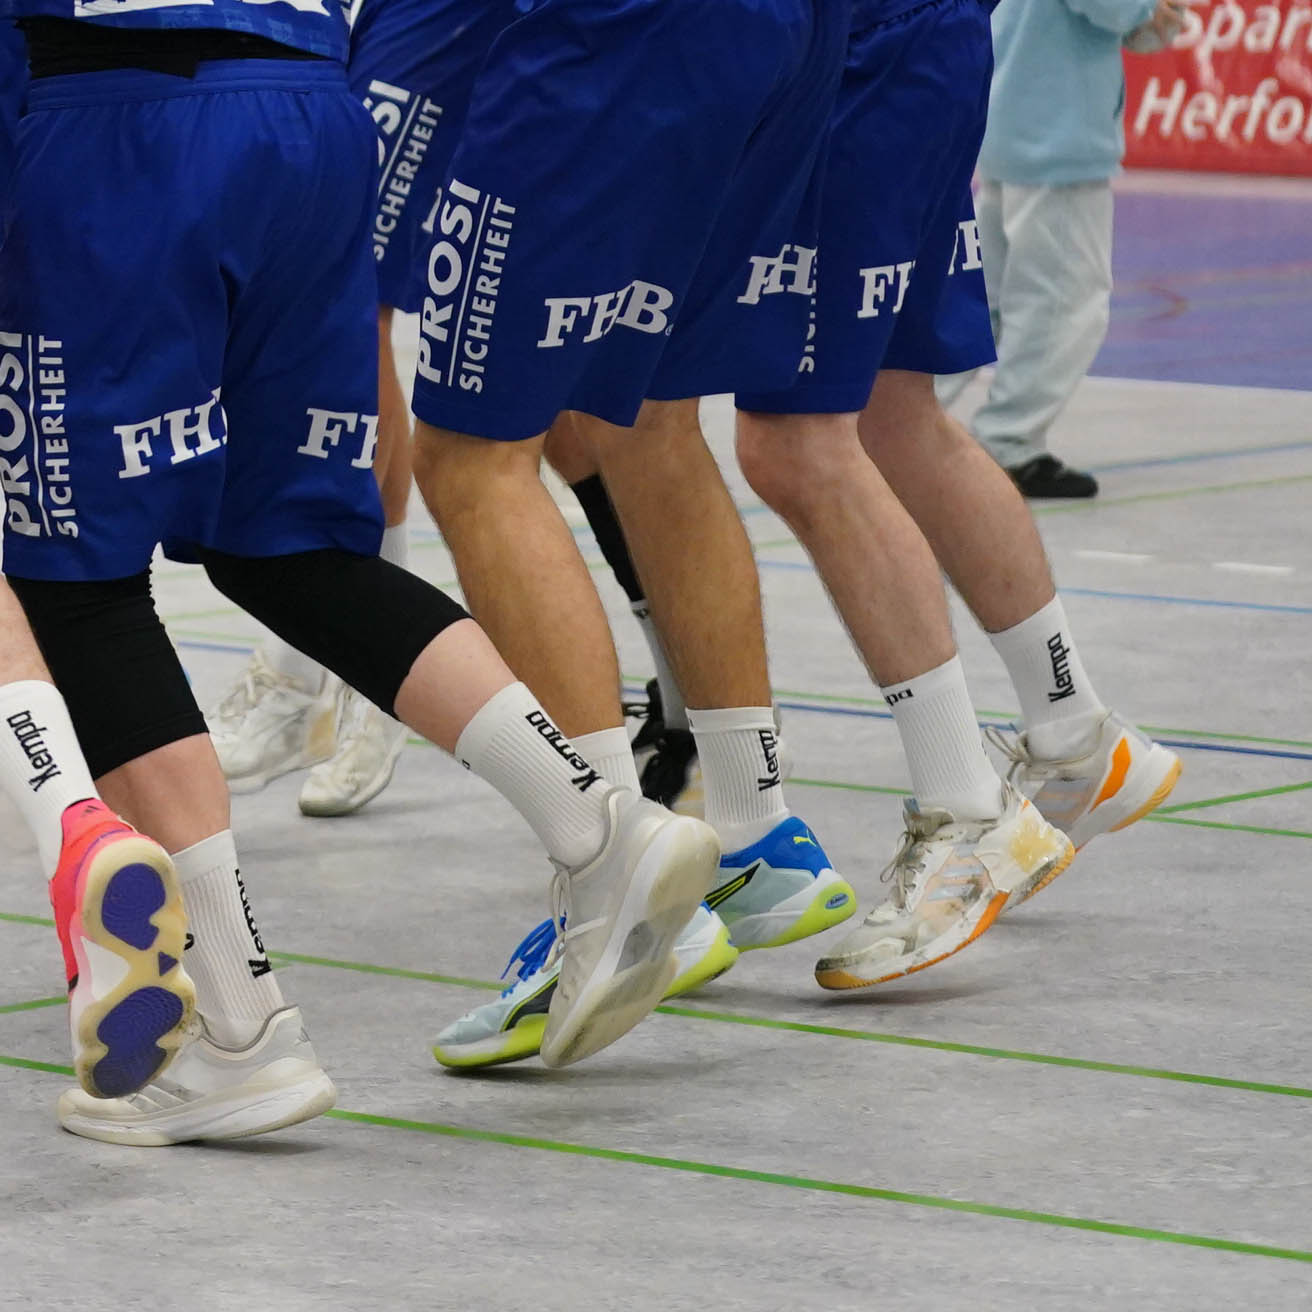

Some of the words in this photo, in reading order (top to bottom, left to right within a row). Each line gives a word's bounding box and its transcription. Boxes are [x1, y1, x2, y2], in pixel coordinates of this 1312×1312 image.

[372, 96, 445, 263] SICHERHEIT
[414, 178, 481, 384] PROSI
[458, 195, 517, 394] SICHERHEIT
[37, 334, 79, 538] SICHERHEIT
[113, 387, 228, 479] FH
[1047, 631, 1076, 703] Kempa
[6, 709, 62, 793] Kempa
[524, 710, 604, 792] Kempa
